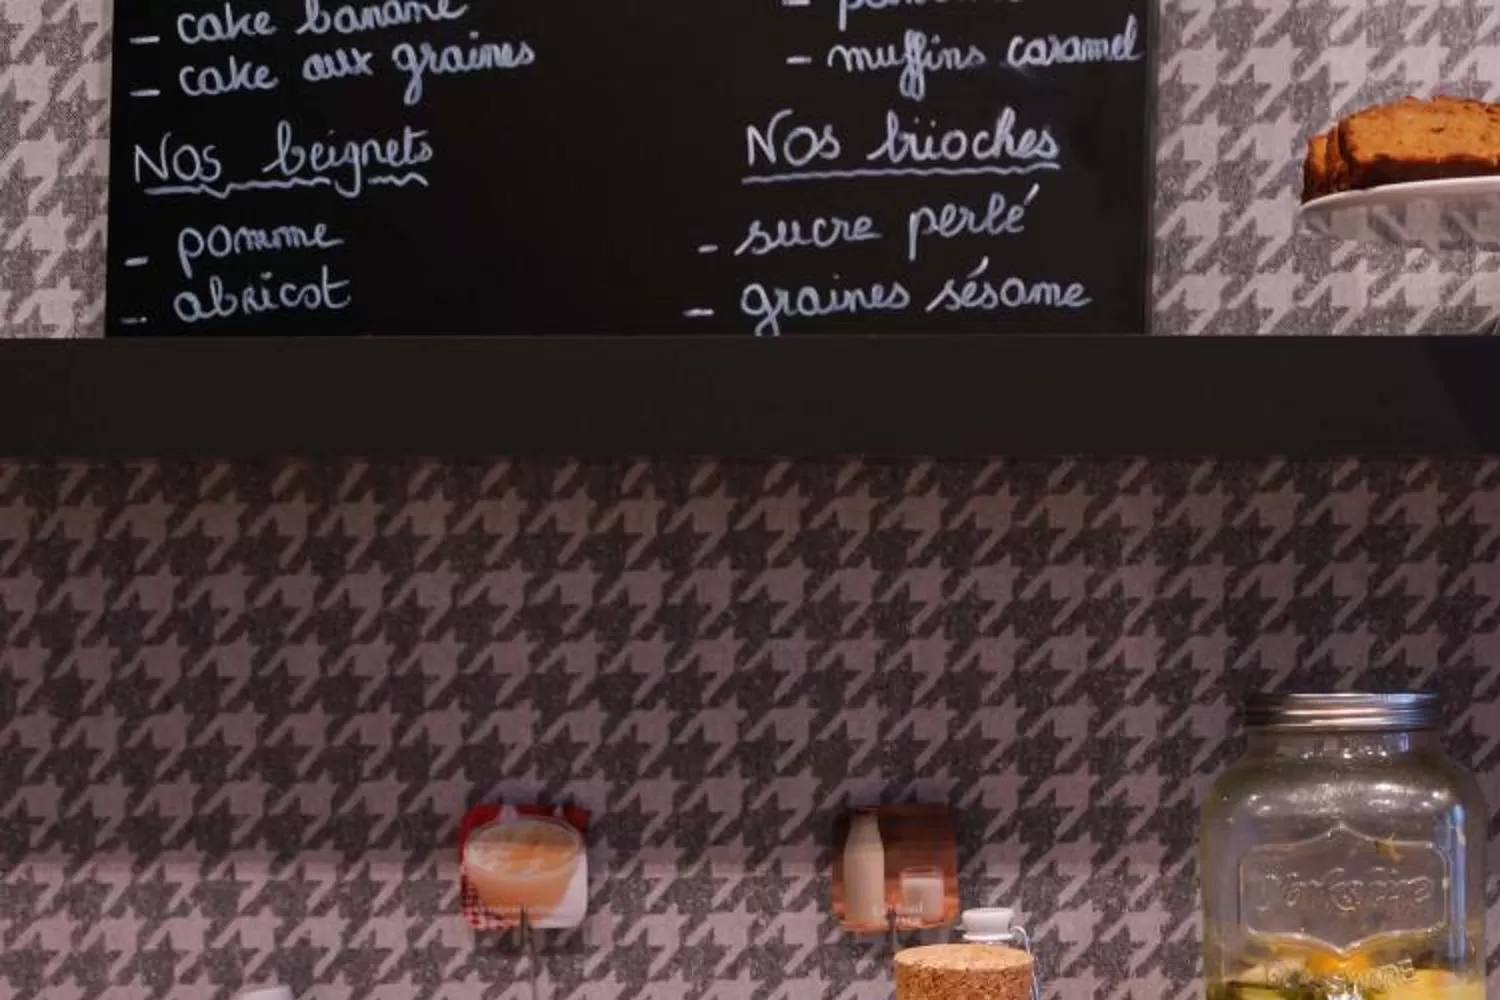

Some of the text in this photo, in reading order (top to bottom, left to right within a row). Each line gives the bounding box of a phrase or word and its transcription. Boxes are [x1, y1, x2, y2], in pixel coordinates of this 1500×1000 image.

[177, 2, 277, 44] cake
[827, 29, 986, 100] muffins
[1007, 14, 1144, 67] caramel
[179, 30, 536, 104] cake aux graines
[262, 121, 433, 197] beignets
[867, 107, 1059, 162] brioches
[177, 223, 344, 278] pomme
[734, 184, 1039, 260] sucre perlé
[174, 265, 351, 324] abricot
[741, 256, 1092, 336] graines sésame
